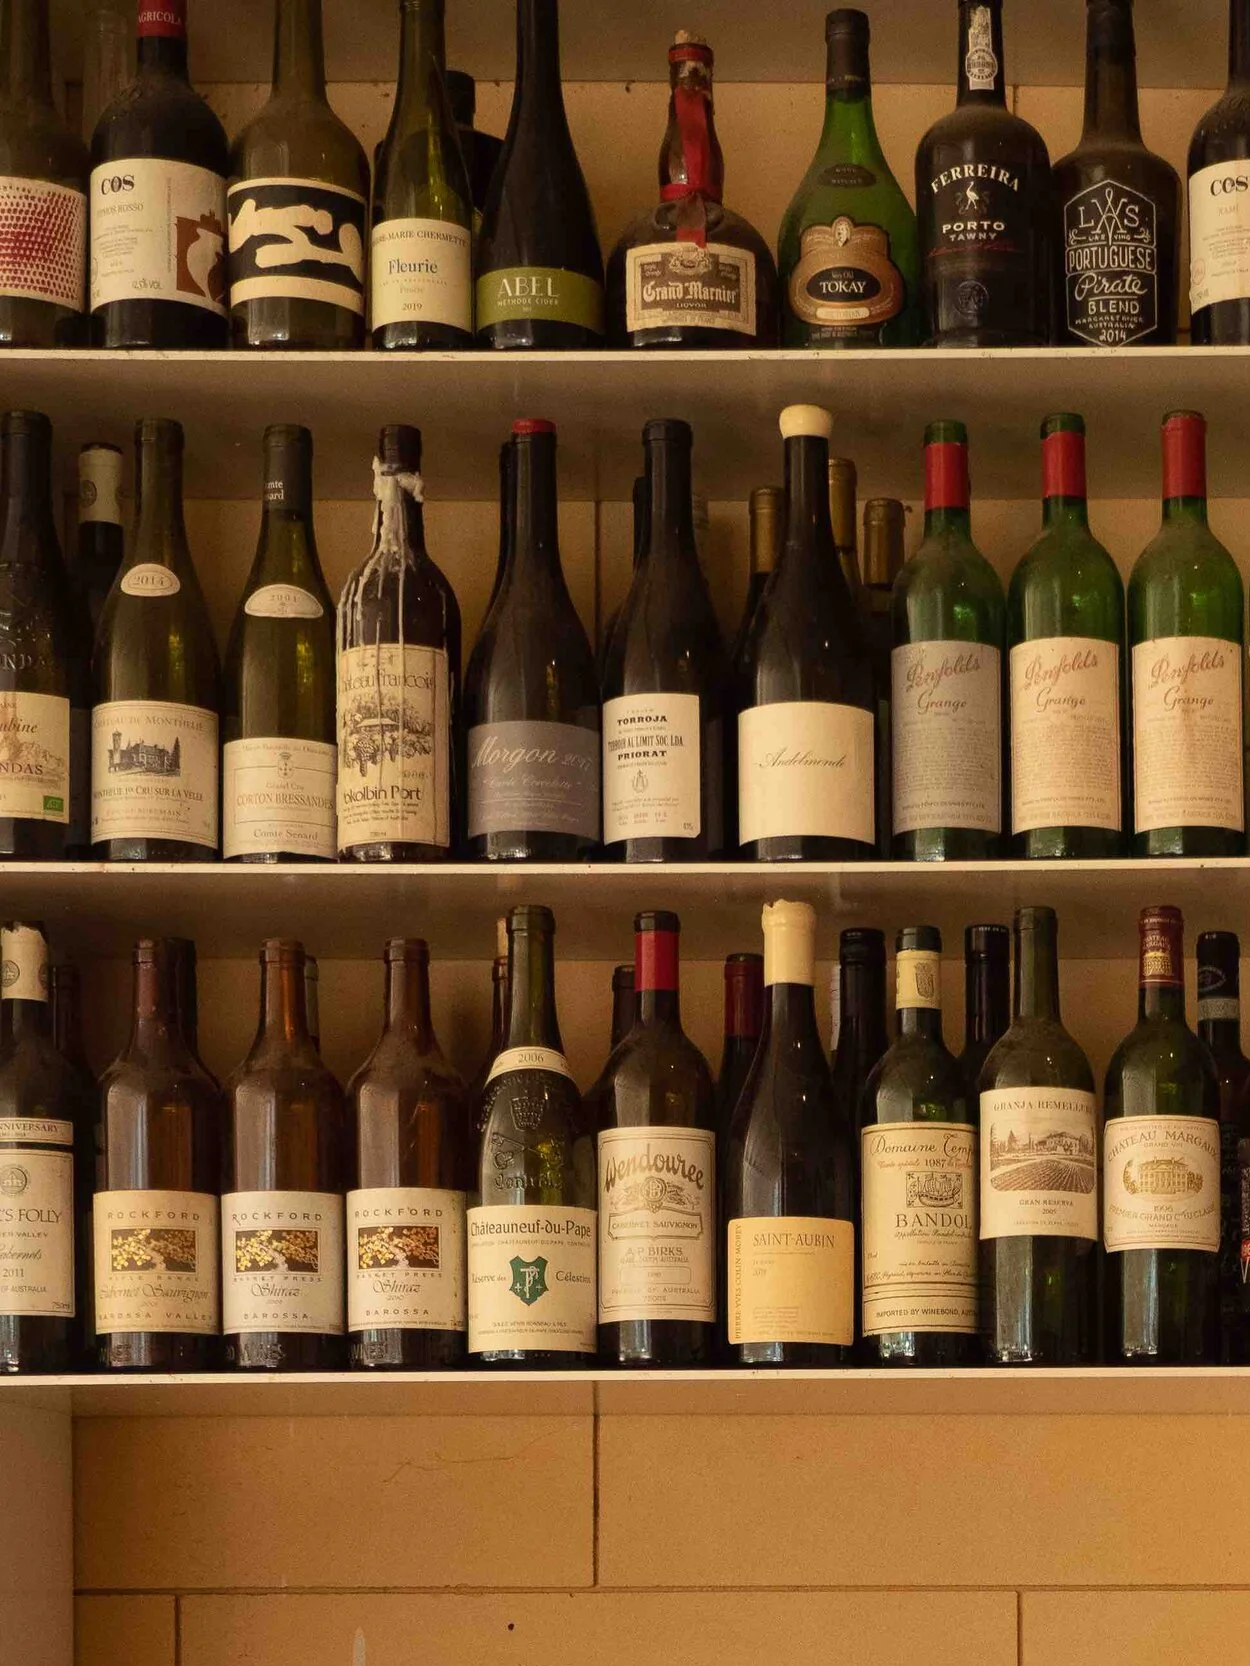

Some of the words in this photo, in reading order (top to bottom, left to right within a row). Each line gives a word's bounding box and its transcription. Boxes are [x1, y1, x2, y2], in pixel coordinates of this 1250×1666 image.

[101, 174, 135, 195] COS
[931, 164, 1019, 194] FERREIRA
[1210, 176, 1249, 196] COS
[942, 221, 1005, 233] PORTO
[950, 233, 996, 241] TAWNY
[1069, 246, 1152, 271] PORTUGUESE
[388, 259, 438, 275] Fleurie
[498, 276, 560, 297] ABEL
[643, 281, 684, 302] Grand
[685, 281, 737, 304] Marnier
[820, 281, 866, 293] TOKAY
[1074, 272, 1148, 300] Pirate
[402, 302, 422, 311] 2019
[1088, 300, 1139, 315] BLEND
[1098, 330, 1126, 342] 2014
[905, 653, 981, 693] Penfolds
[1024, 649, 1099, 691] Penfolds
[1148, 649, 1225, 691] Penfolds
[917, 688, 967, 715] Grange
[1036, 687, 1086, 713] Grange
[1164, 687, 1214, 712] Grange
[617, 714, 668, 726] TORROJA
[471, 735, 557, 774] Morgon
[618, 750, 667, 760] PRIORAT
[391, 785, 422, 800] Port
[993, 1101, 1034, 1112] GRANJA
[871, 1134, 937, 1156] Domaine
[1165, 1130, 1218, 1162] MARGAUX
[604, 1143, 704, 1194] Wendouree
[924, 1158, 947, 1167] 1987
[19, 1209, 62, 1223] FOLLY
[108, 1211, 201, 1220] ROCKFORD
[232, 1212, 323, 1226] ROCKFORD
[354, 1207, 443, 1217] ROCKFORD
[471, 1219, 591, 1239] Châteauneuf-du-Pape
[653, 1221, 698, 1229] SAUVIGNON
[753, 1233, 835, 1249] SAINT-AUBIN
[648, 1246, 683, 1257] BIRKS
[3, 1268, 24, 1278] 2011
[143, 1283, 210, 1303] Sauvignon
[251, 1281, 300, 1297] Shiraz
[373, 1279, 421, 1294] Shiraz
[244, 1312, 310, 1321] BAROSSA
